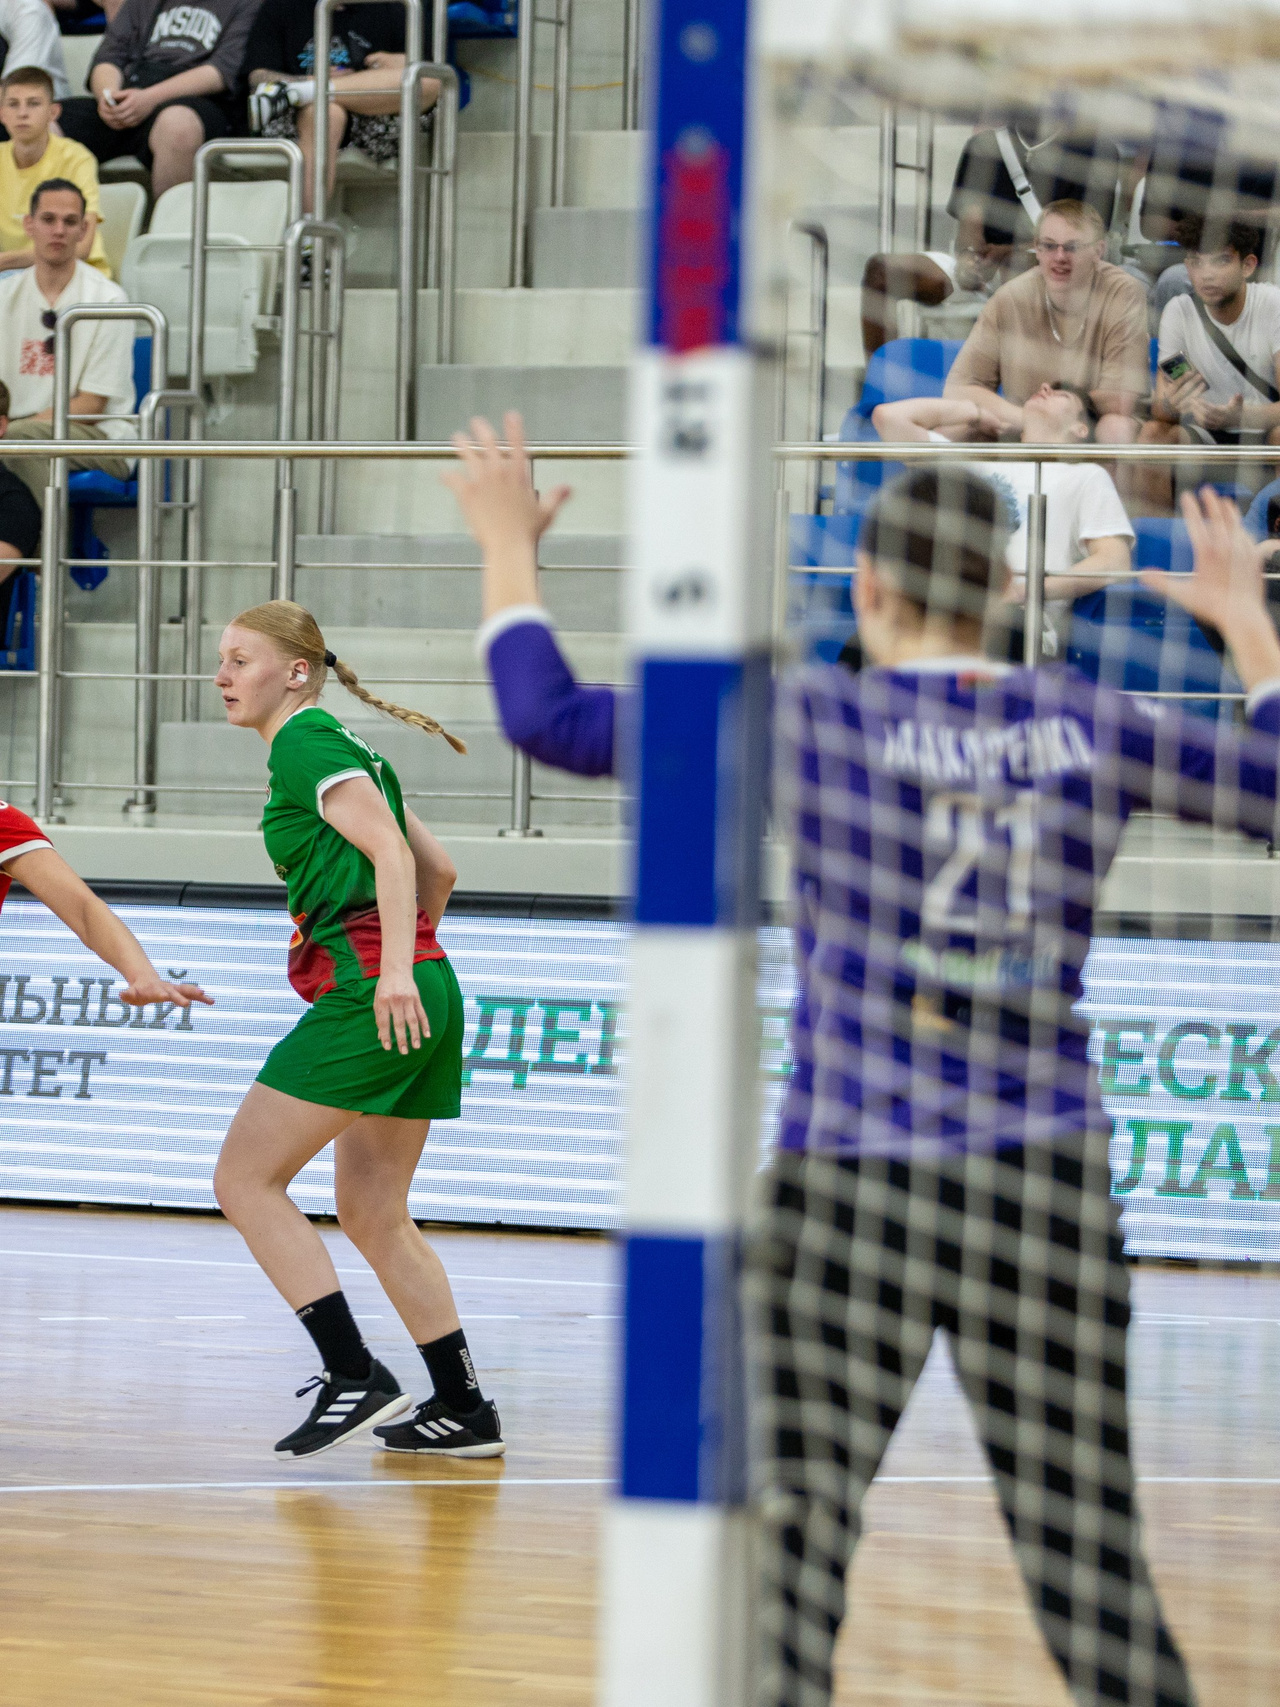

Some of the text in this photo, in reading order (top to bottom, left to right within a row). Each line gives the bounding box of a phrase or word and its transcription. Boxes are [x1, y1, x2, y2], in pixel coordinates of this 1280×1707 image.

[921, 790, 1040, 932] 21
[1112, 1121, 1280, 1201] ЛА
[458, 1347, 481, 1389] Kempa
